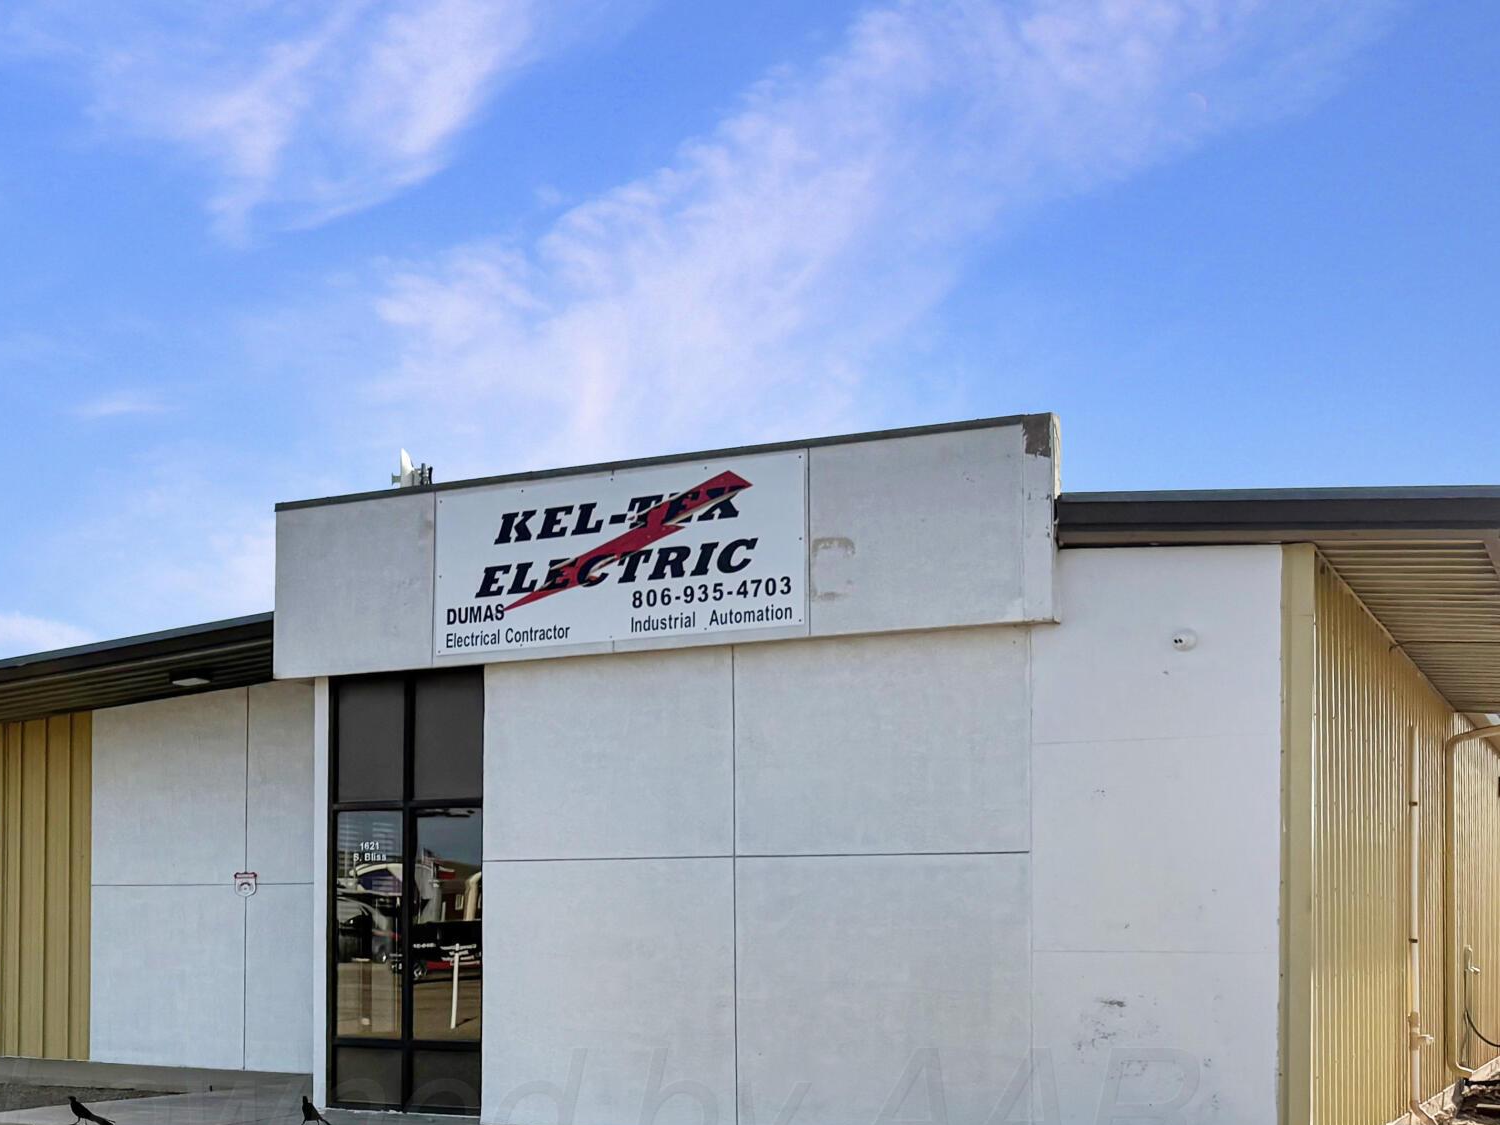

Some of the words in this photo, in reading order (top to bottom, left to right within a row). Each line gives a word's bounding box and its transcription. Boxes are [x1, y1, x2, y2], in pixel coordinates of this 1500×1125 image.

[494, 484, 749, 545] KEL-TEX
[475, 537, 759, 599] ELECTRIC
[631, 576, 792, 609] 806-935-4703
[446, 603, 505, 626] DUMAS
[630, 611, 696, 633] Industrial
[709, 604, 793, 627] Automation
[446, 629, 501, 650] Electrical
[505, 625, 571, 645] Contractor
[360, 841, 379, 851] 1621
